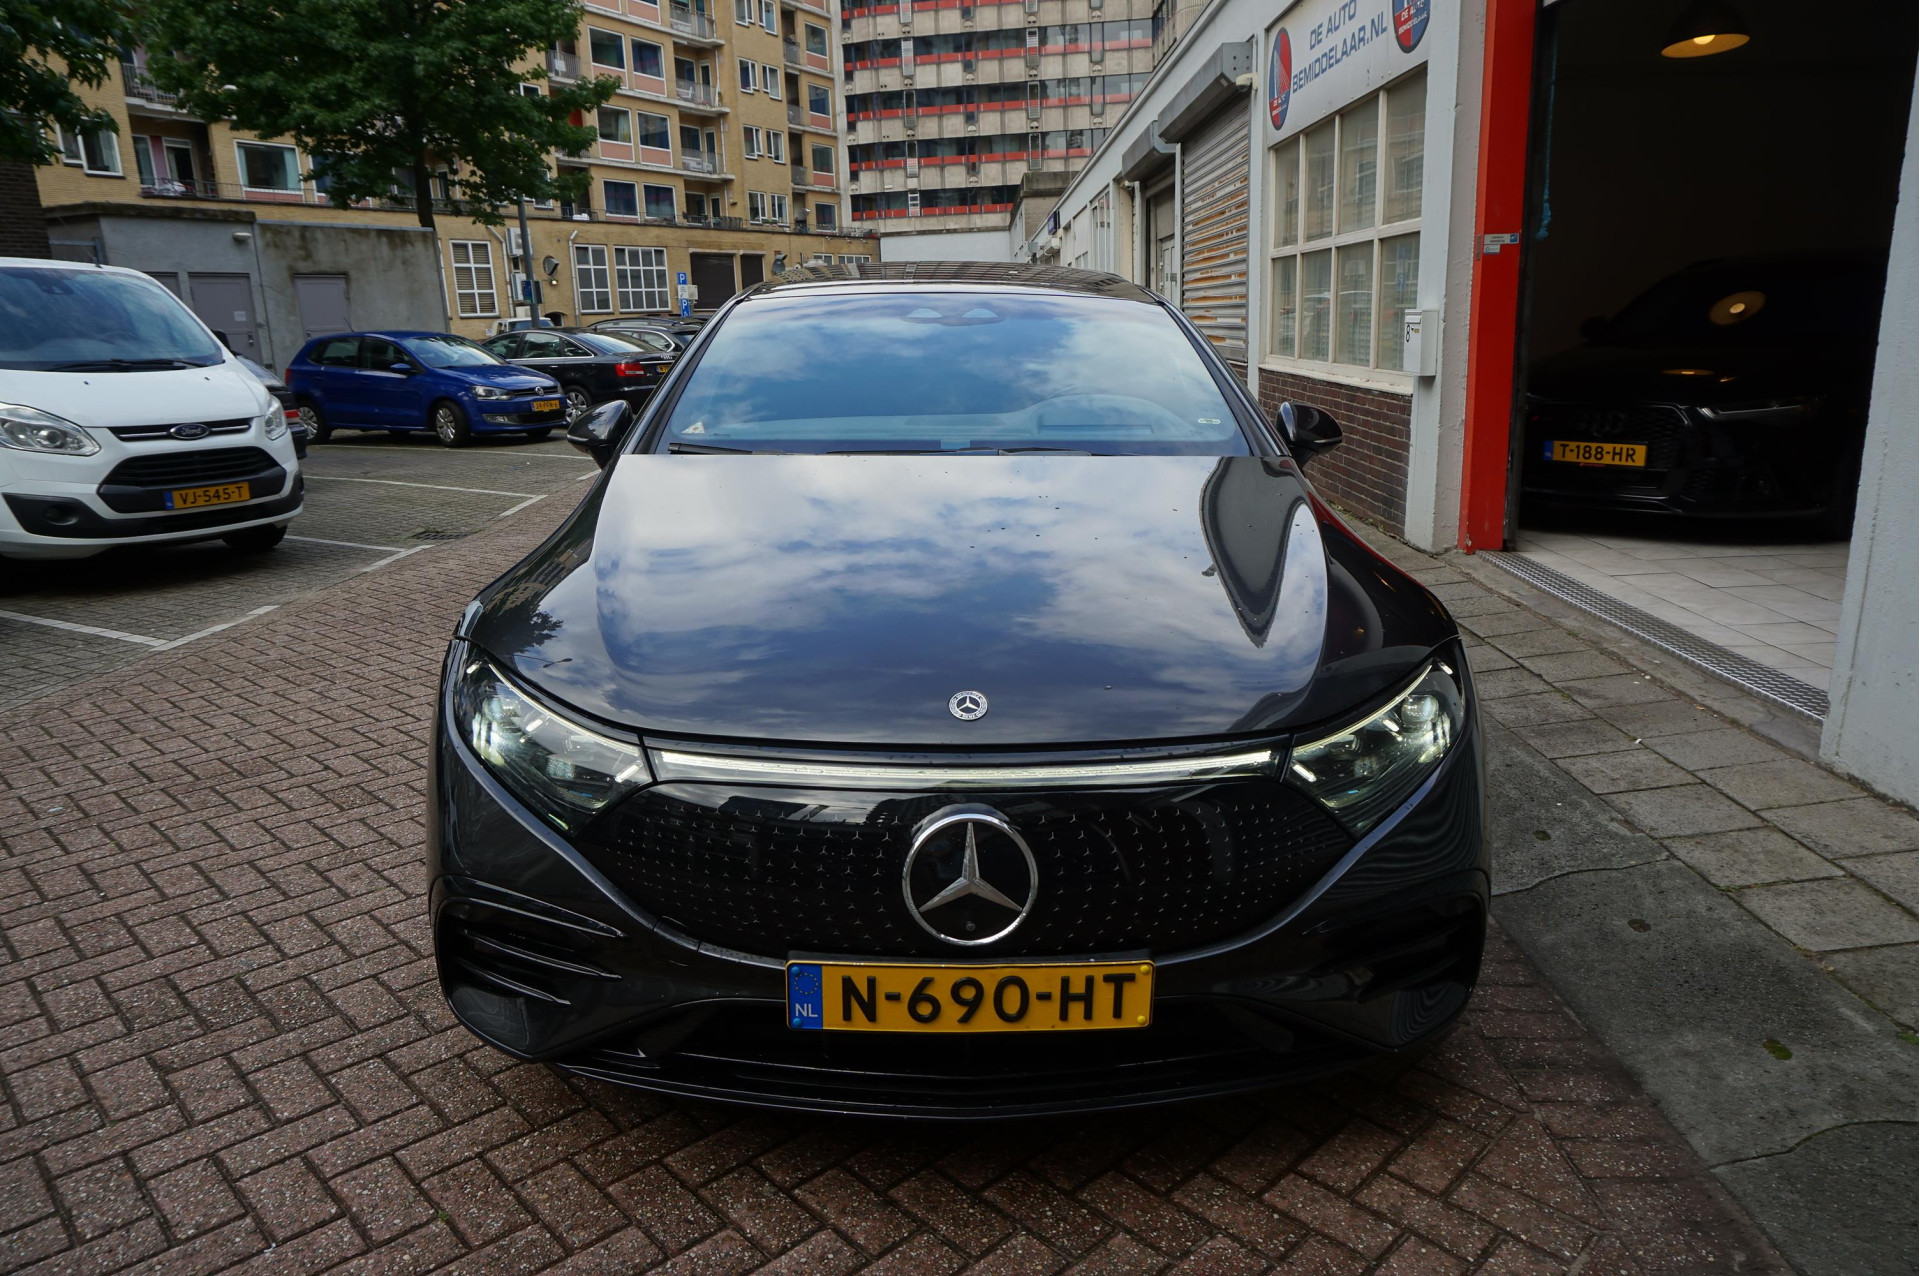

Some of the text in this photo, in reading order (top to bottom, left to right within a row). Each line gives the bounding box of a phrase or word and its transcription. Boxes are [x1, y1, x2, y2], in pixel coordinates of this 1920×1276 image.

[1309, 0, 1357, 51] DE AUTO
[1292, 11, 1388, 94] BEMIDDELAAR.NL
[680, 273, 686, 284] P
[682, 300, 688, 309] P
[1405, 324, 1411, 342] 8
[181, 425, 202, 435] Ford
[1560, 444, 1636, 463] T-188-HR
[179, 486, 244, 505] VJ-545-T
[795, 973, 1136, 1023] NL N-690-HT
